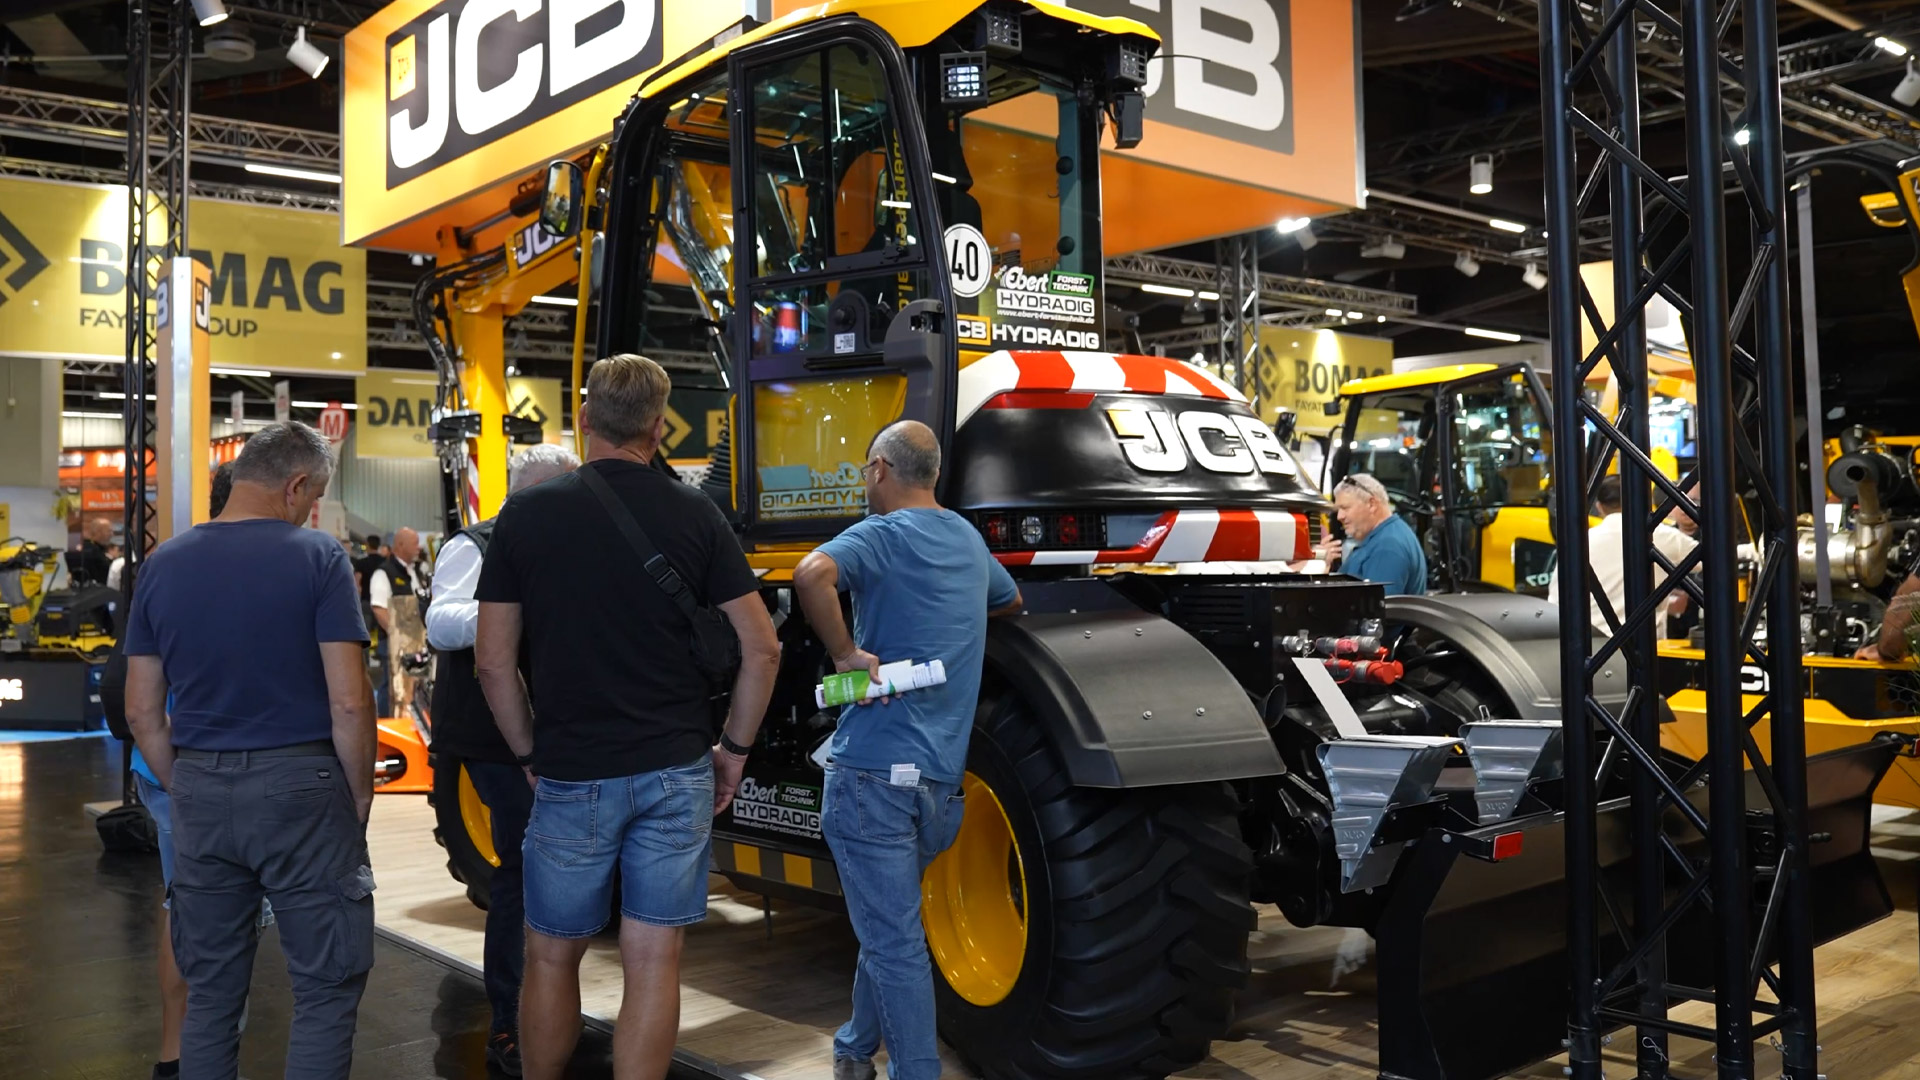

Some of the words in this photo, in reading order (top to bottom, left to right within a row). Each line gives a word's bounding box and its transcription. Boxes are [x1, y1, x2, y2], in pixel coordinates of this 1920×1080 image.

[517, 222, 567, 265] JC
[951, 239, 979, 282] 40
[1005, 266, 1049, 292] Ebert
[1052, 282, 1089, 294] TECHNIK
[1000, 293, 1093, 314] HYDRADIG
[992, 323, 1100, 349] HYDRADIG
[1107, 409, 1296, 476] JCB
[740, 777, 778, 803] Ebert
[781, 793, 815, 806] TECHNIK
[736, 801, 819, 828] HYDRADIG
